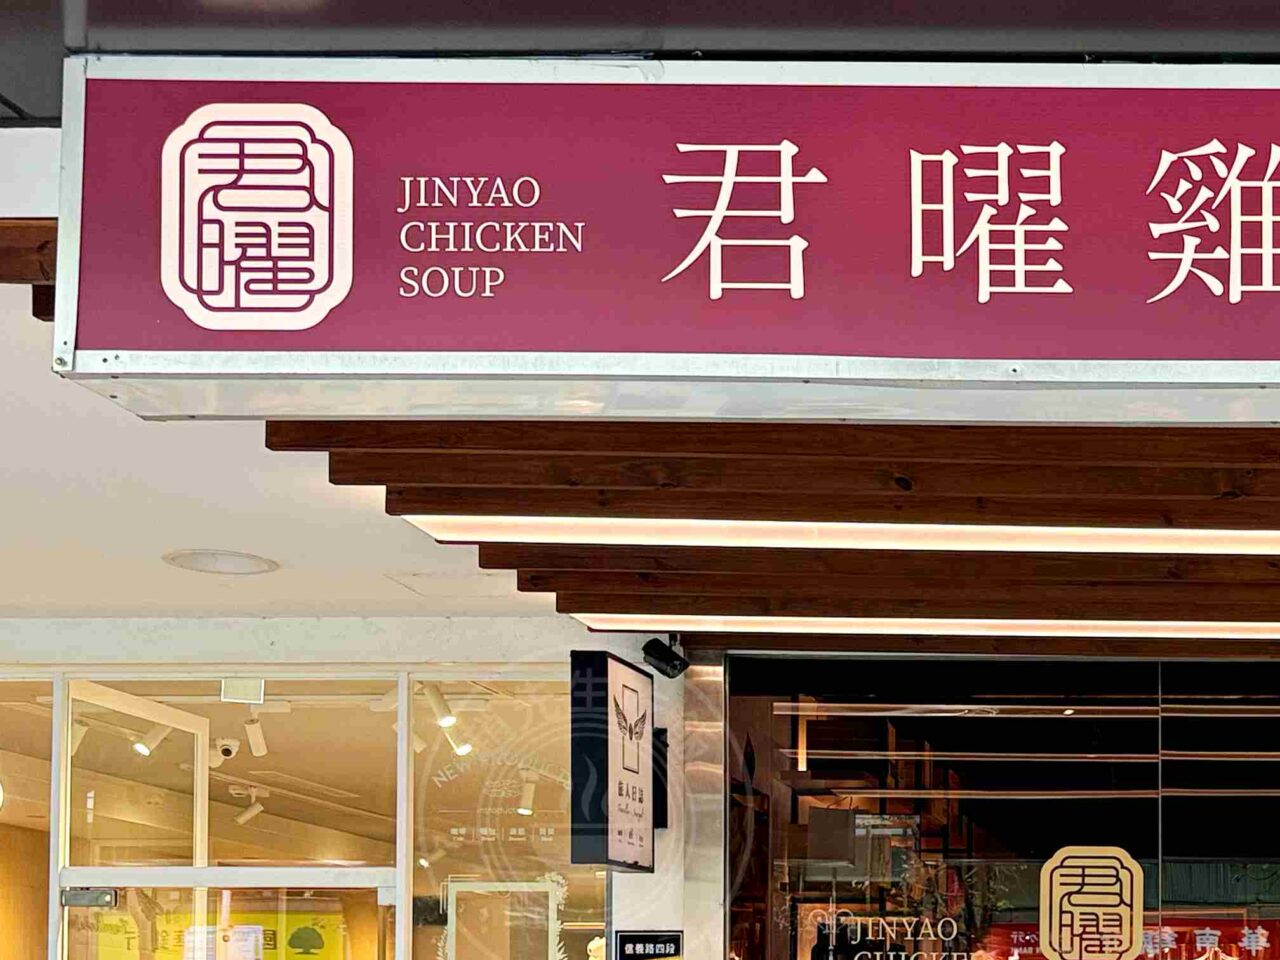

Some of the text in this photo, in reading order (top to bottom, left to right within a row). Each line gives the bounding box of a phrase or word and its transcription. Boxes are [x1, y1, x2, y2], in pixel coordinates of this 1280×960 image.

[397, 175, 541, 213] JINYAO
[398, 221, 586, 254] CHICKEN
[398, 266, 506, 299] SOUP
[852, 917, 958, 942] JINYAO
[625, 943, 676, 955] 信義路四段
